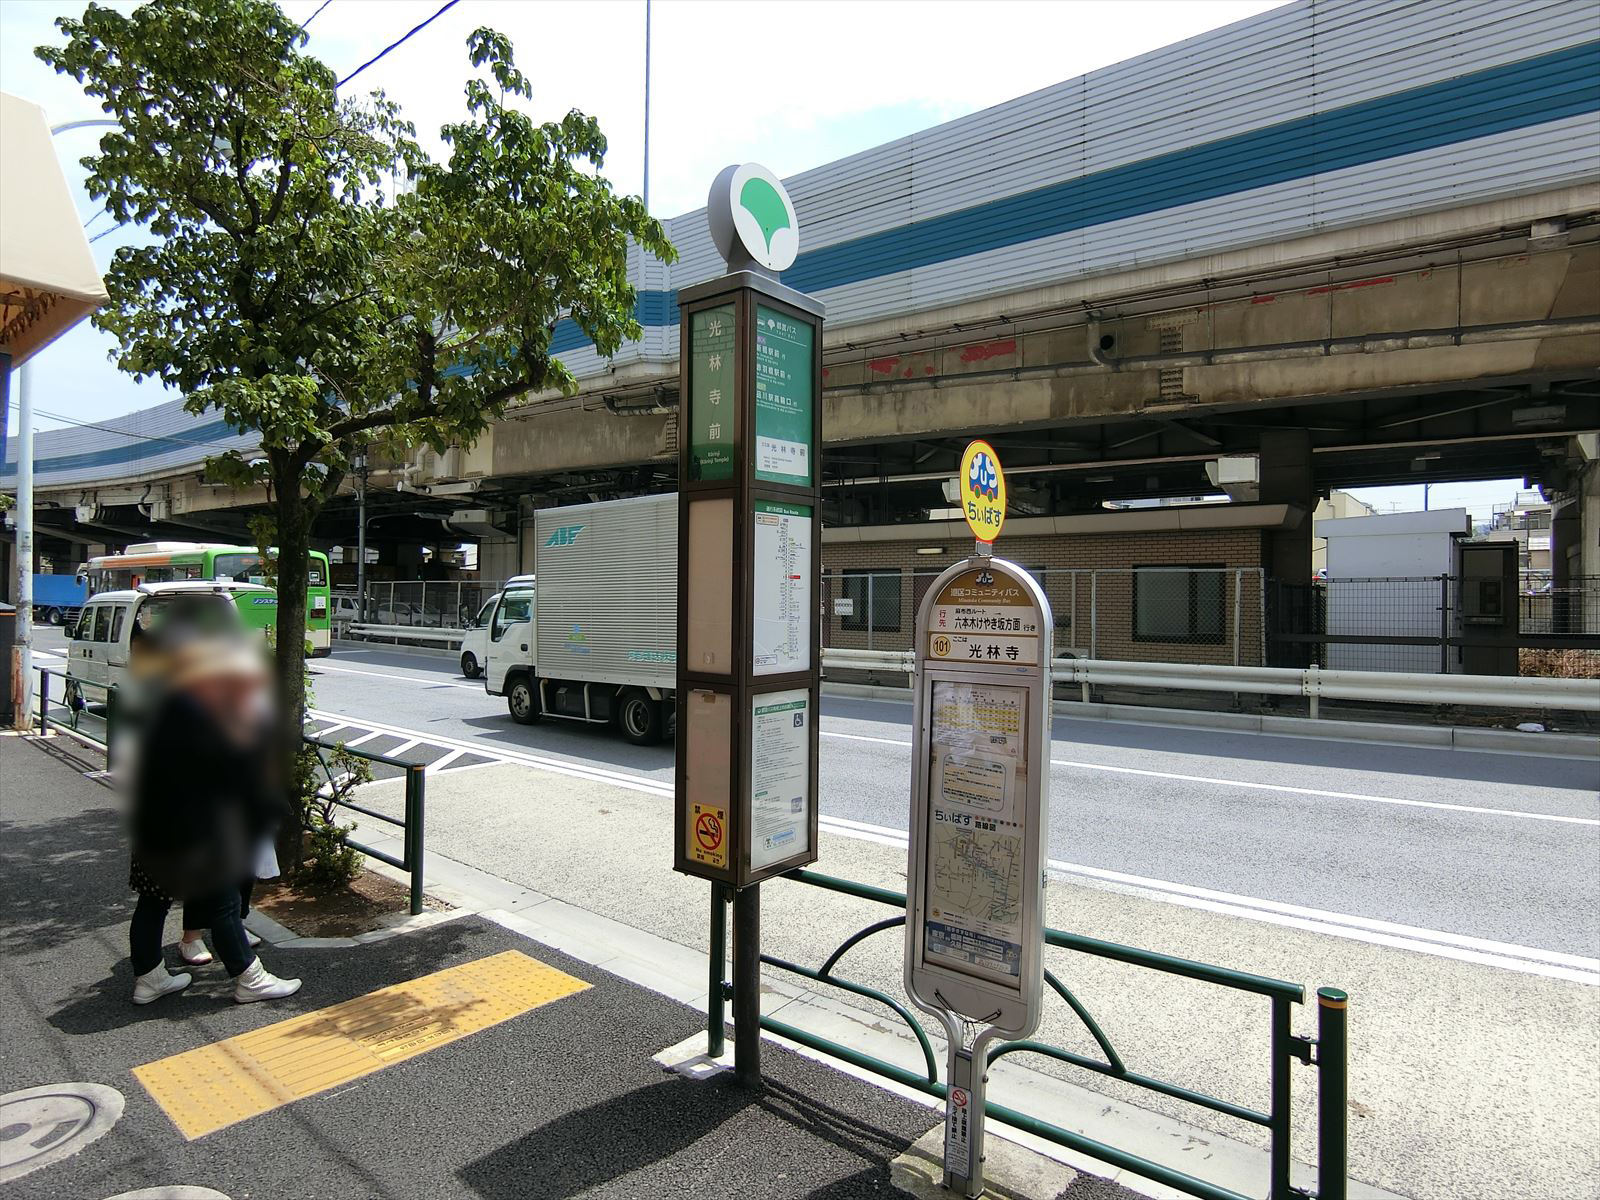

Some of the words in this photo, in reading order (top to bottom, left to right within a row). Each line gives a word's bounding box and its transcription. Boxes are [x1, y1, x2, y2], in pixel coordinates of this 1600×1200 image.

[708, 320, 721, 440] 光林寺前
[950, 587, 1020, 597] 港区コミュニティバス
[938, 610, 947, 627] 行先
[954, 617, 1021, 631] 六本木けやき坂方面
[934, 640, 948, 652] 101
[968, 644, 1019, 661] 光林寺
[974, 820, 997, 832] 路線図
